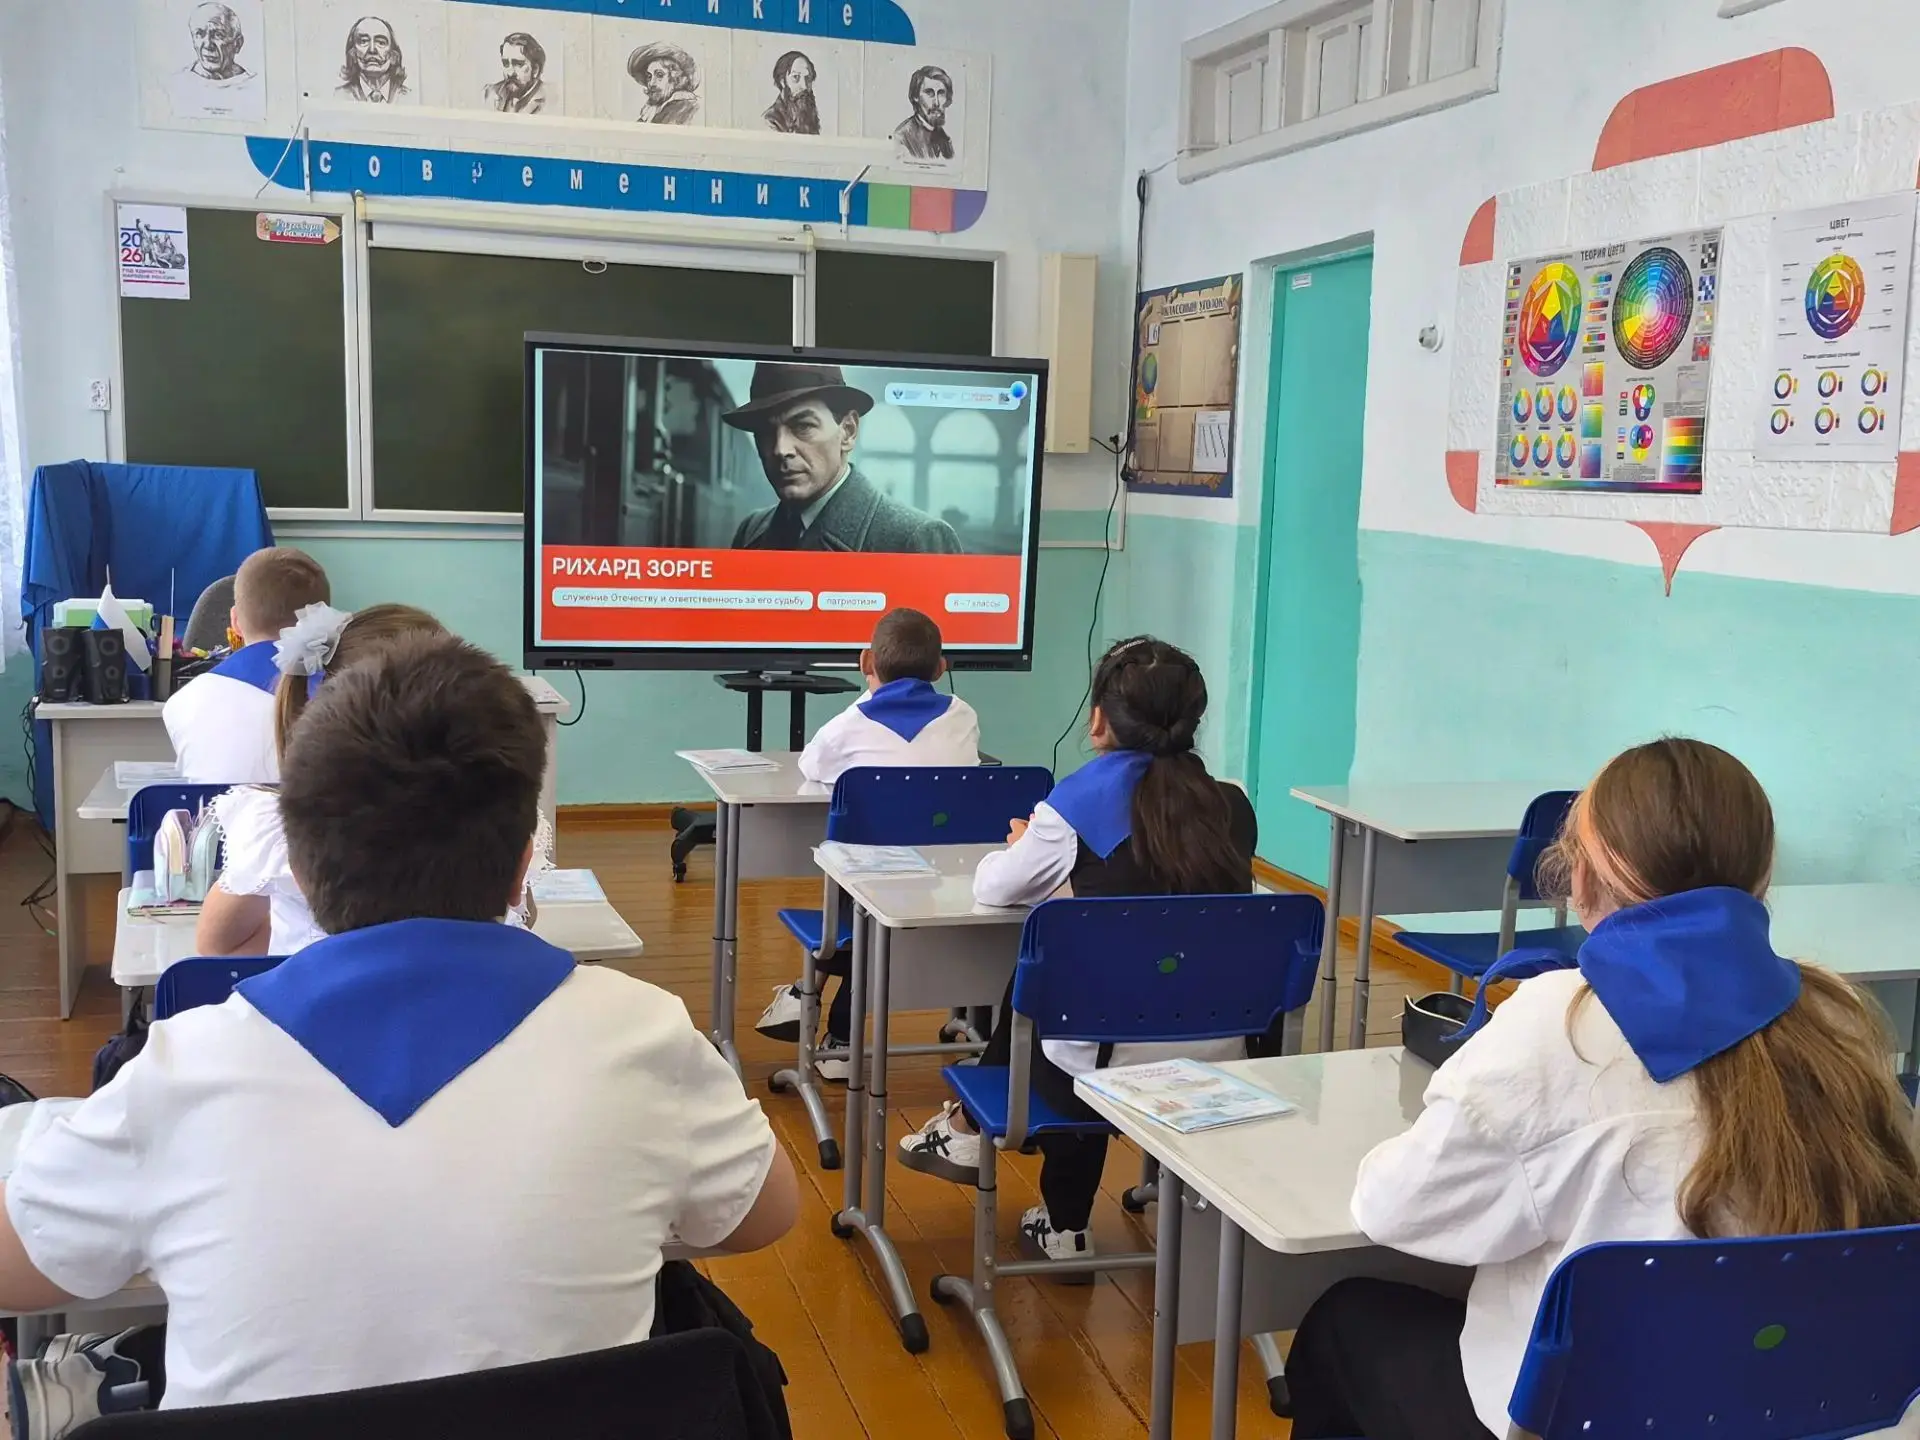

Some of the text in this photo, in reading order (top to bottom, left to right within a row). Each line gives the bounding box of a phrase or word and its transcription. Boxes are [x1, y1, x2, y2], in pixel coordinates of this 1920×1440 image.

[1829, 218, 1851, 230] ЦВЕТ
[120, 232, 142, 247] 20
[121, 247, 143, 263] 26
[1580, 247, 1606, 262] ТЕОРИЯ
[552, 557, 713, 579] РИХАРД ЗОРГЕ
[562, 593, 608, 603] служение
[611, 593, 658, 604] Отечеству
[668, 596, 742, 604] ответственность
[774, 596, 805, 606] судьбу
[826, 597, 877, 607] патриотизм
